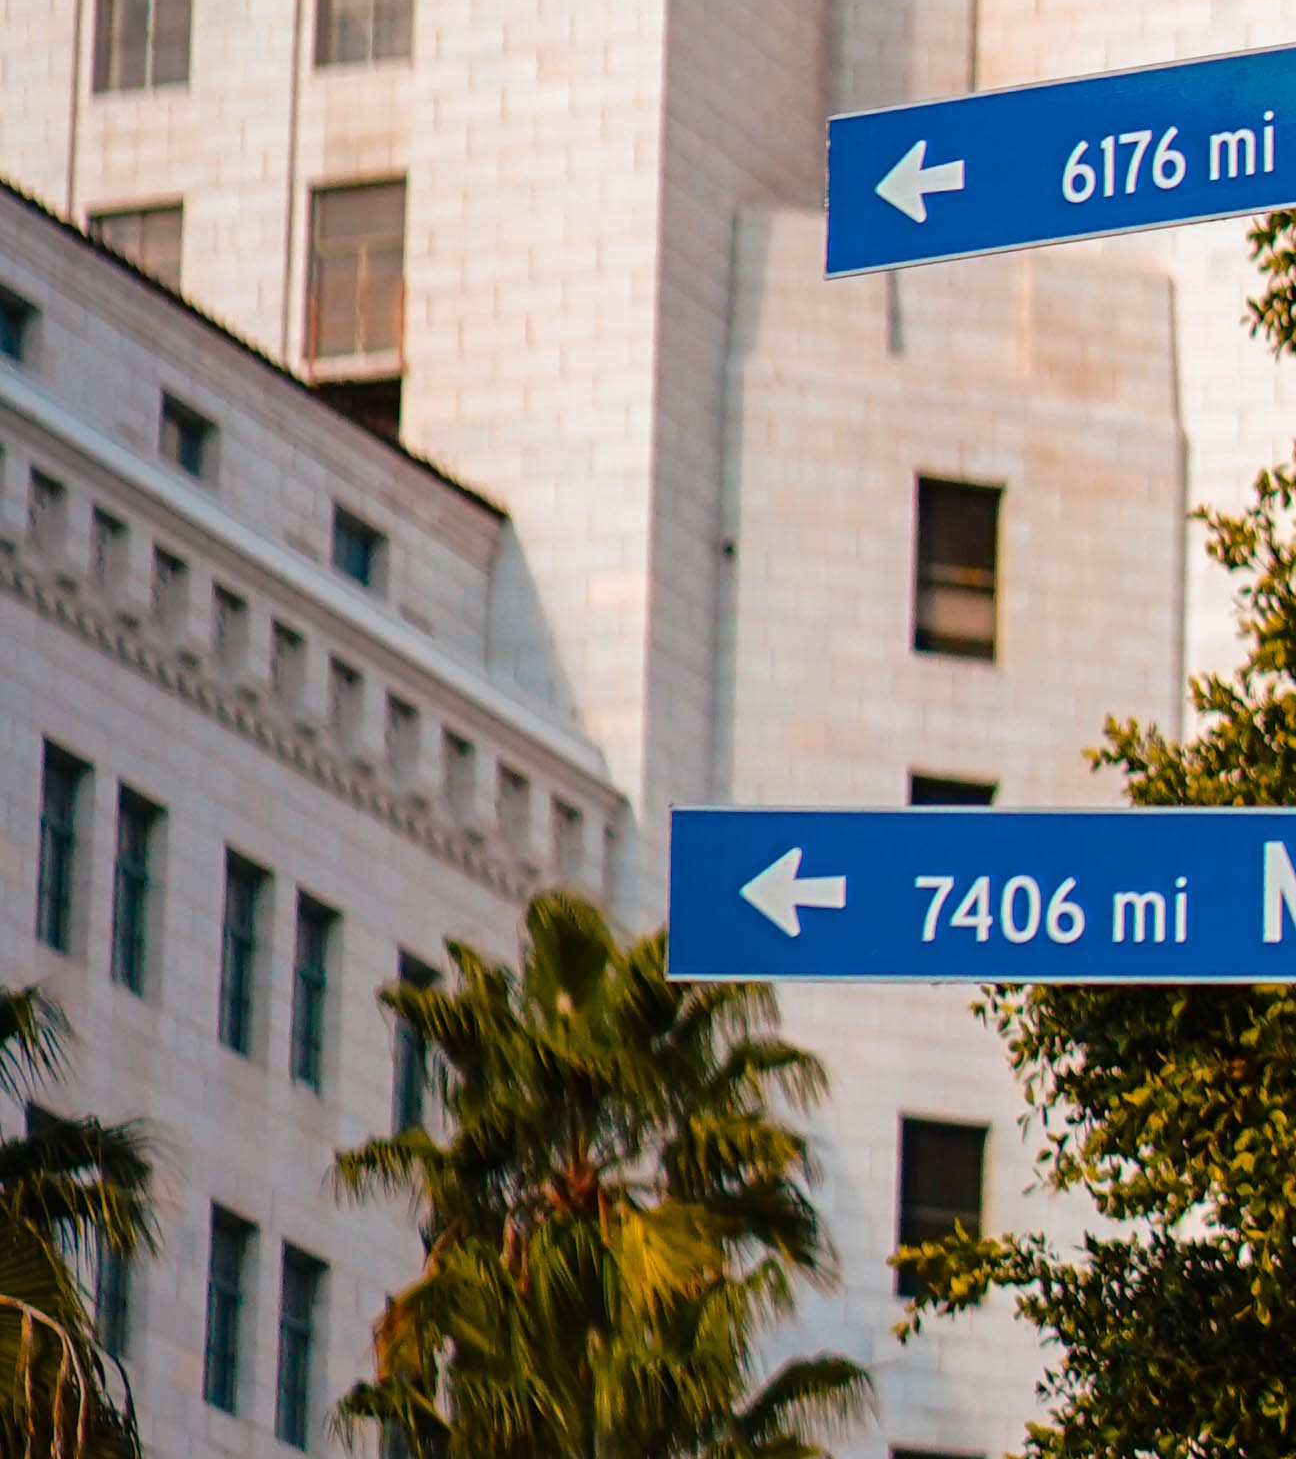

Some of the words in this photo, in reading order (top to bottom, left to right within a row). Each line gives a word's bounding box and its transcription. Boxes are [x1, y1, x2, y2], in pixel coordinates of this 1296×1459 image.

[1063, 126, 1187, 203] 6176
[1210, 110, 1275, 181] mi
[916, 875, 1085, 944] 7406
[1113, 876, 1188, 943] mi
